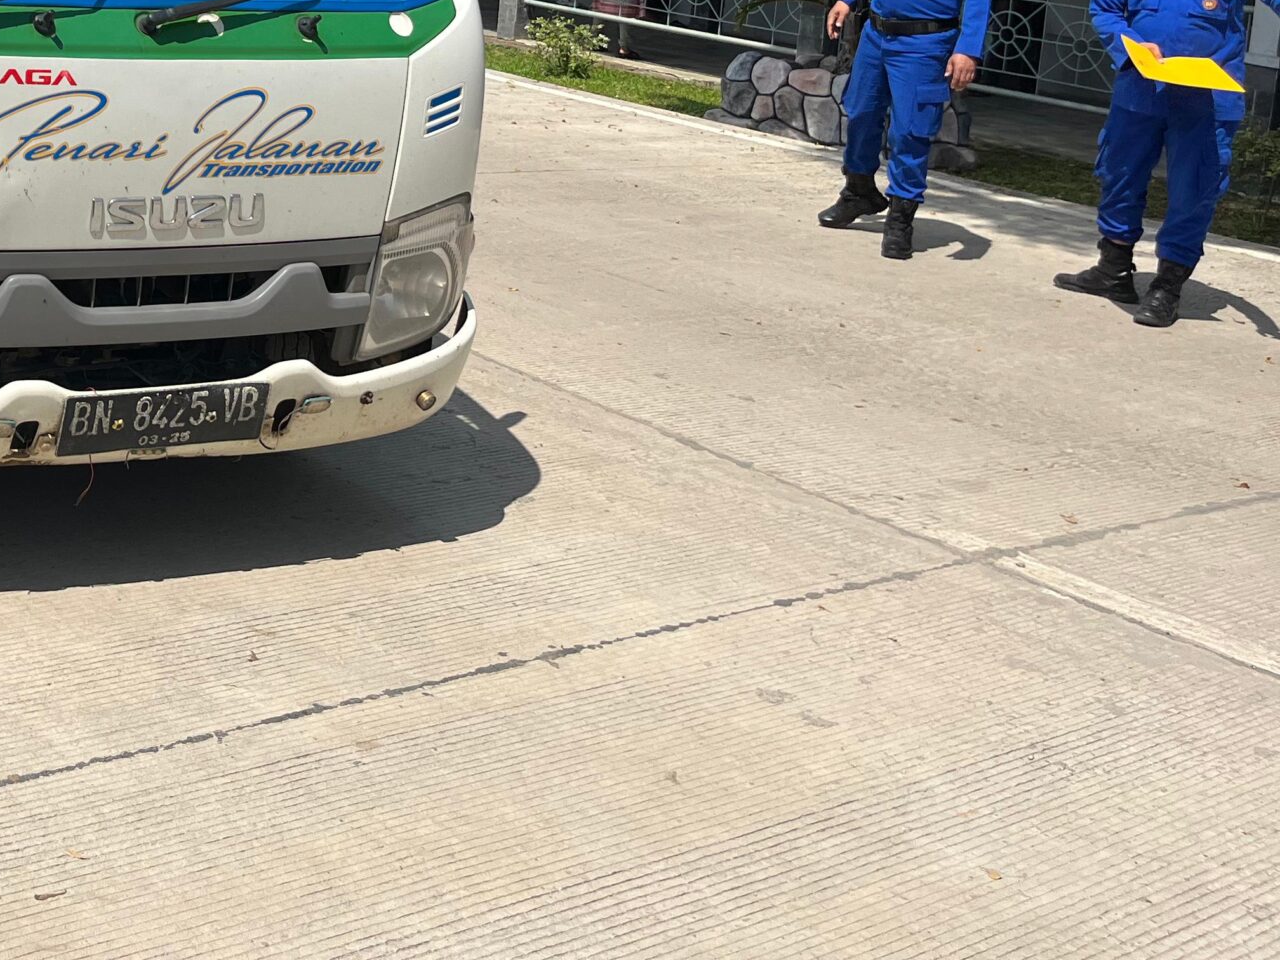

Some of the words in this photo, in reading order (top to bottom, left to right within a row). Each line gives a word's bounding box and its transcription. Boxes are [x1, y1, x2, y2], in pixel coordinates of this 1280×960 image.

[161, 85, 386, 196] Jalanan
[197, 158, 384, 180] Transportation
[87, 192, 266, 239] ISUZU
[71, 400, 114, 437] BN
[133, 390, 210, 432] 8425
[223, 386, 260, 424] VB
